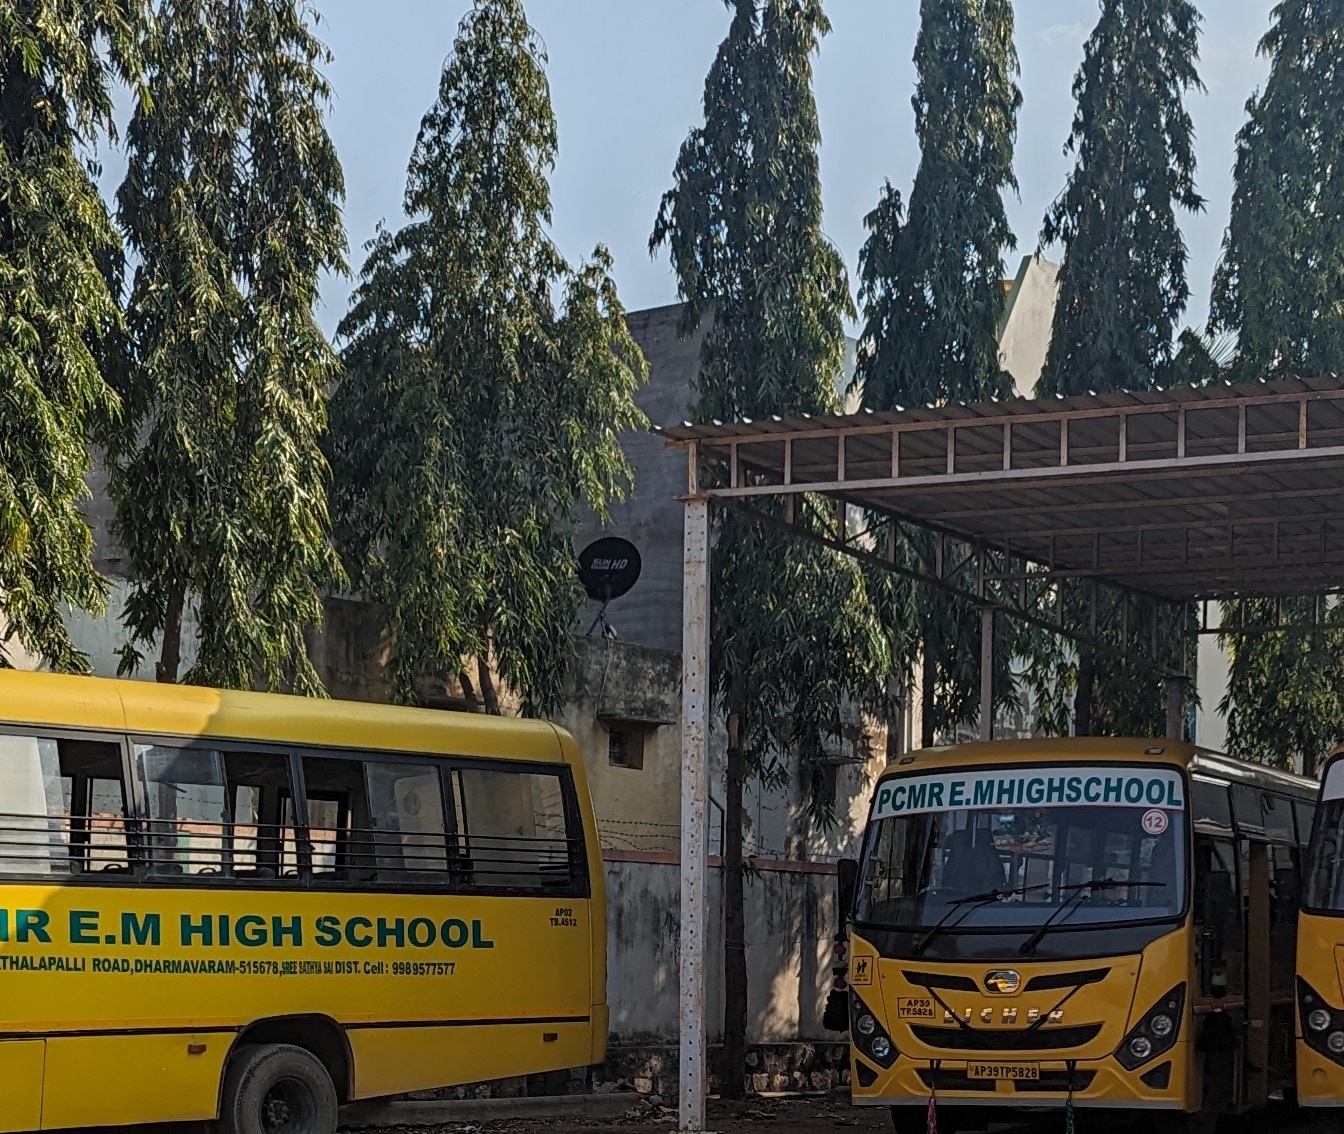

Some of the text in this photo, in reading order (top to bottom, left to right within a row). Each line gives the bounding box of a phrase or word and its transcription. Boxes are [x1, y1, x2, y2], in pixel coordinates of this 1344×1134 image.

[611, 558, 629, 570] HD
[877, 782, 945, 814] PCMR
[1145, 816, 1163, 828] 12
[555, 908, 573, 917] AP02
[68, 910, 161, 946] E.M
[180, 913, 303, 948] HIGH
[314, 916, 495, 949] SCHOOL
[391, 961, 456, 976] 9989577577
[906, 999, 931, 1007] AP39
[973, 1065, 1038, 1079] AP39TP5828
